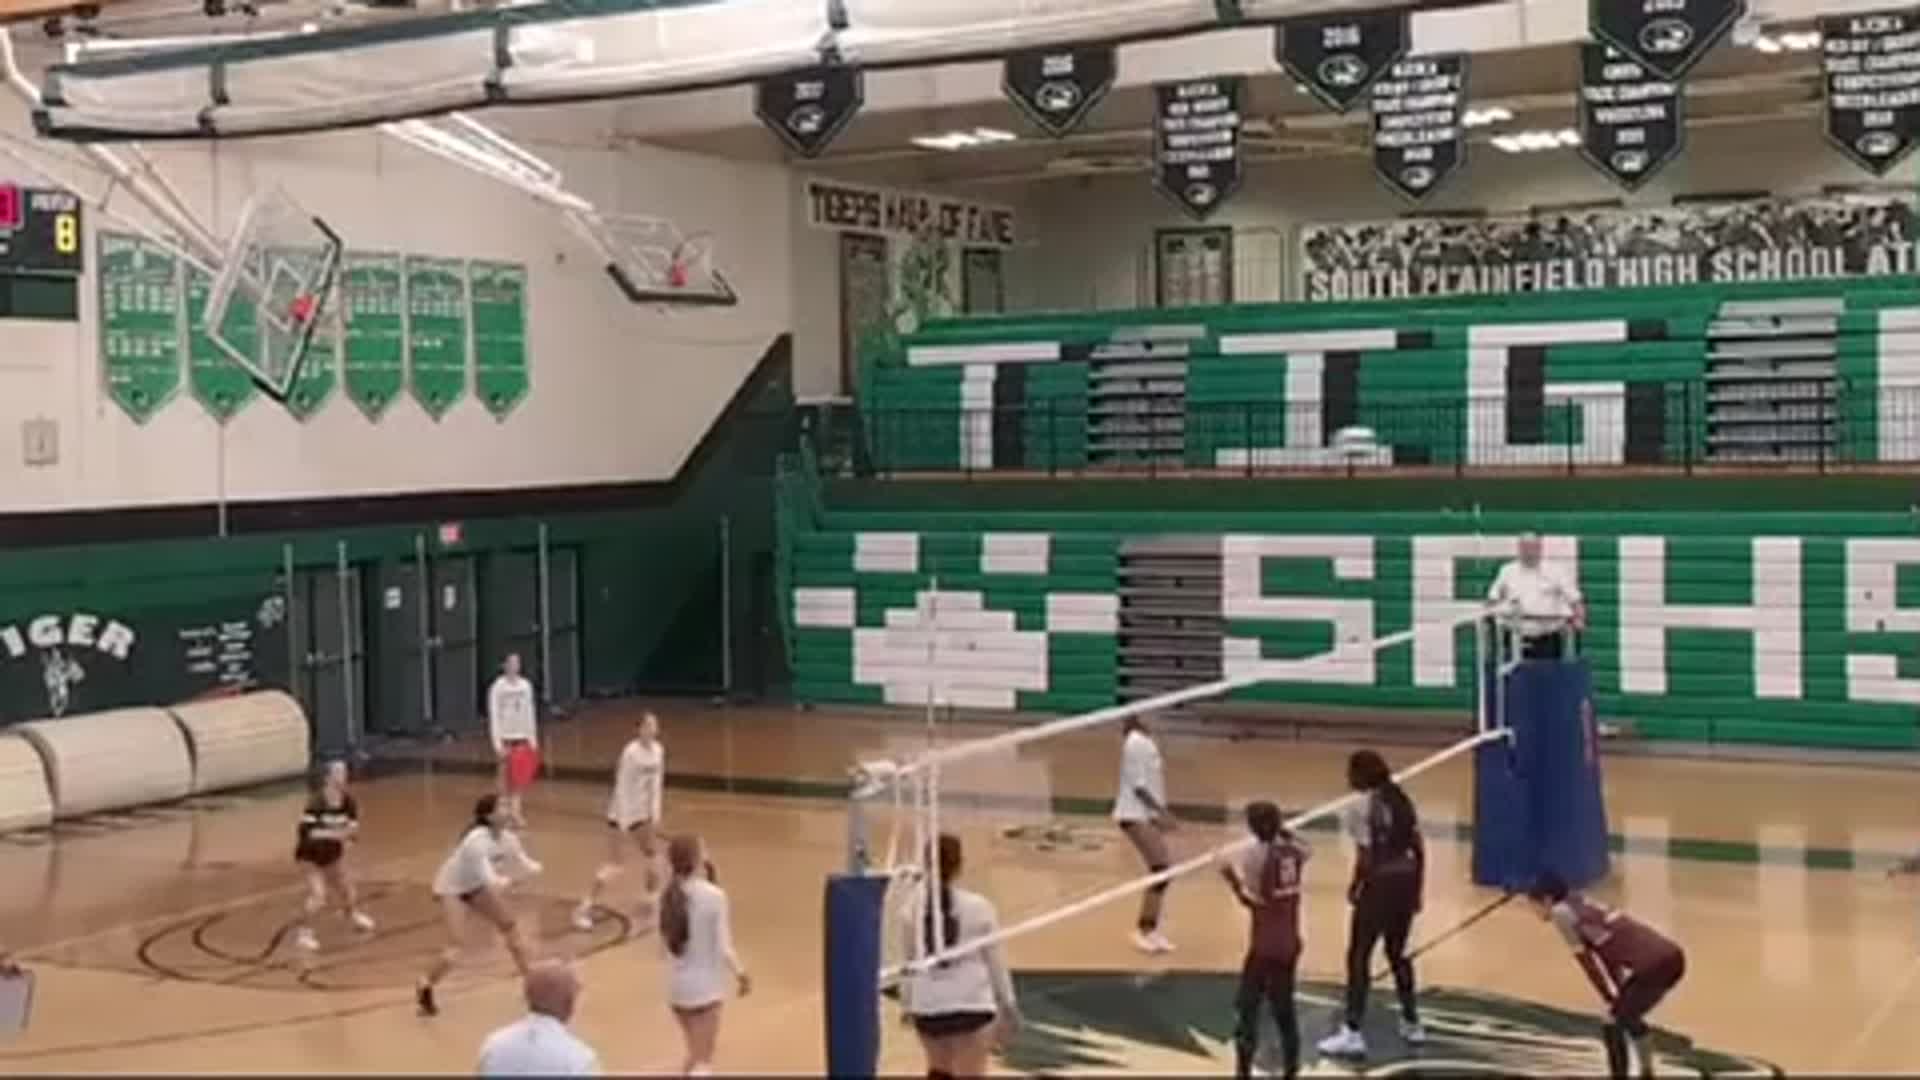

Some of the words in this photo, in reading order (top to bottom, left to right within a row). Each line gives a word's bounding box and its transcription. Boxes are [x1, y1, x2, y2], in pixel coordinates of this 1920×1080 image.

[56, 214, 76, 252] 8
[1311, 267, 1409, 301] SOUTH
[1422, 258, 1605, 296] PLAINFIELD
[1618, 253, 1698, 287] HIGH
[1711, 246, 1845, 283] SCHOOL
[1867, 239, 1920, 275] AT
[907, 308, 1920, 468] TIG
[0, 613, 134, 659] IGER
